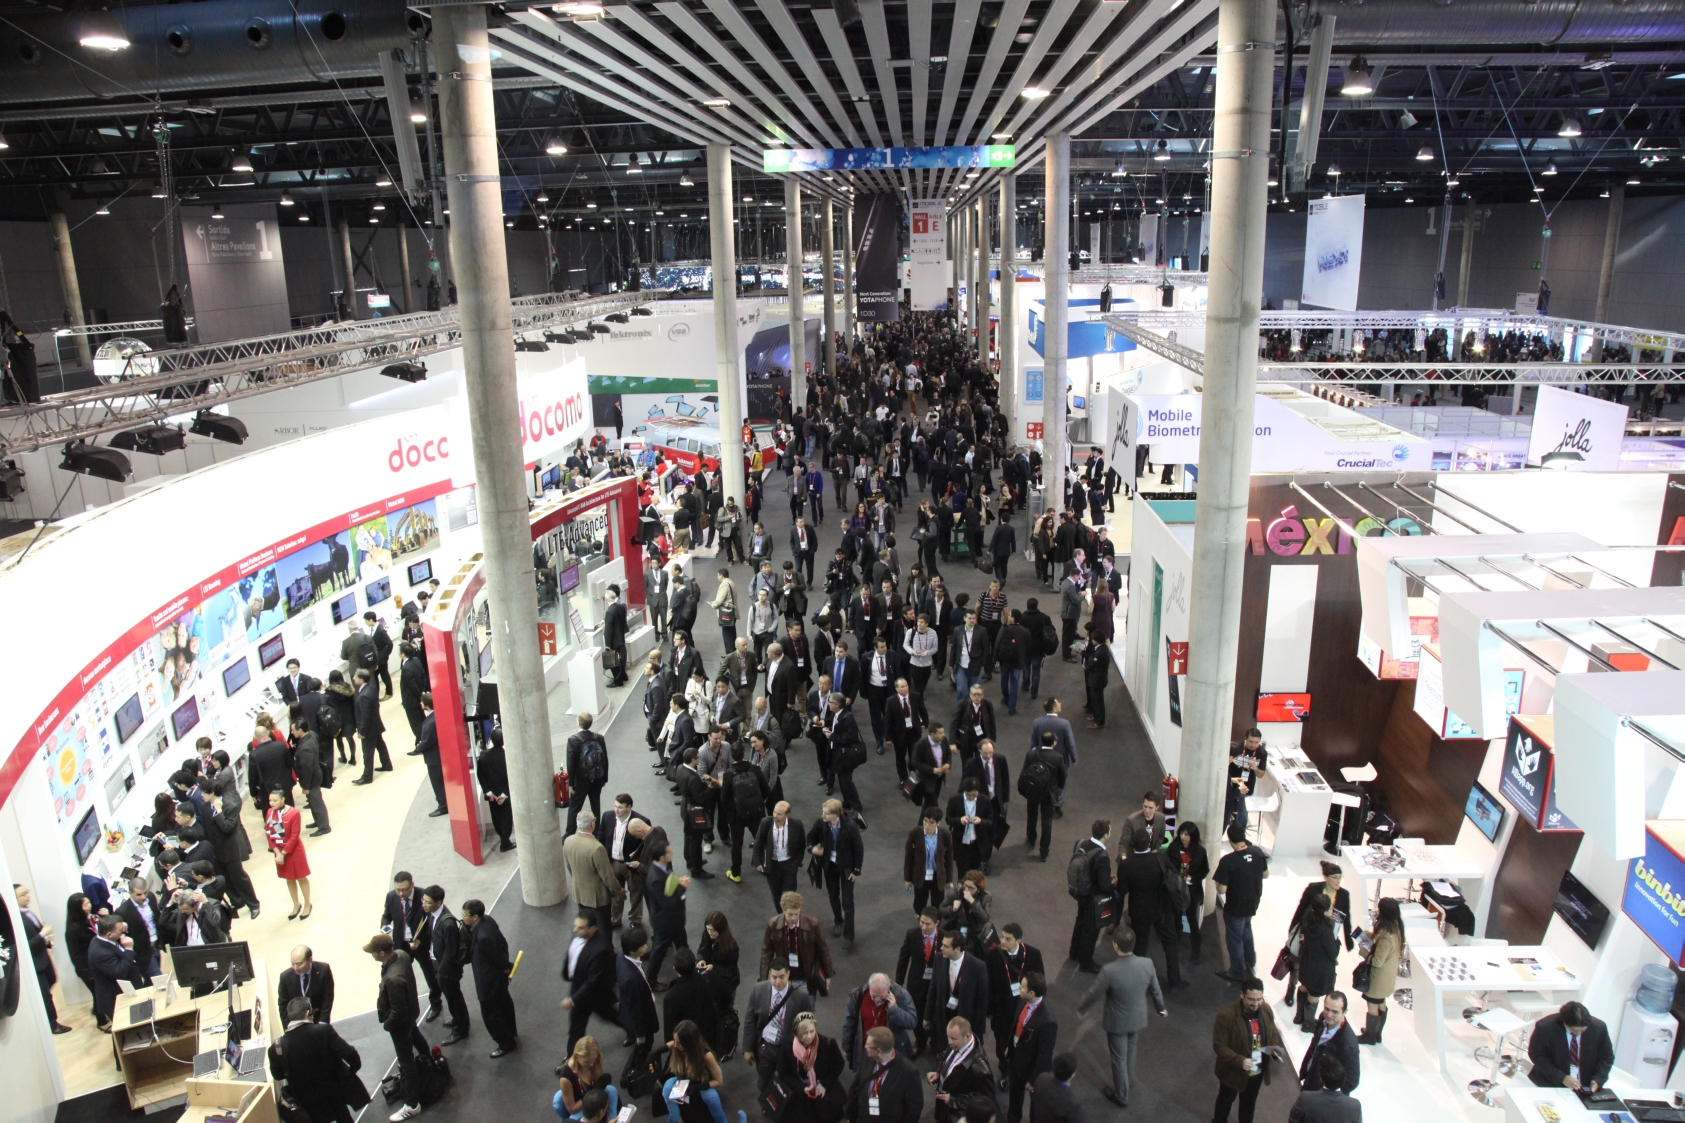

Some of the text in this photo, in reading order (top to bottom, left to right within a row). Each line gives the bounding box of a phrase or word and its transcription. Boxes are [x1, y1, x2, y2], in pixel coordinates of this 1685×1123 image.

[883, 148, 894, 167] 1
[1426, 206, 1436, 234] 1
[208, 224, 230, 234] Sortida
[918, 221, 923, 232] 1
[933, 221, 939, 232] E
[212, 241, 229, 250] Altres
[256, 220, 272, 259] 1
[1148, 410, 1192, 422] Mobile
[1148, 424, 1201, 437] Biometr
[1552, 418, 1592, 453] jolla
[404, 434, 418, 443] NTT
[1337, 458, 1393, 468] CrucialTec
[548, 509, 608, 556] LTE-Advanced
[1634, 881, 1679, 927] Innovation for fun
